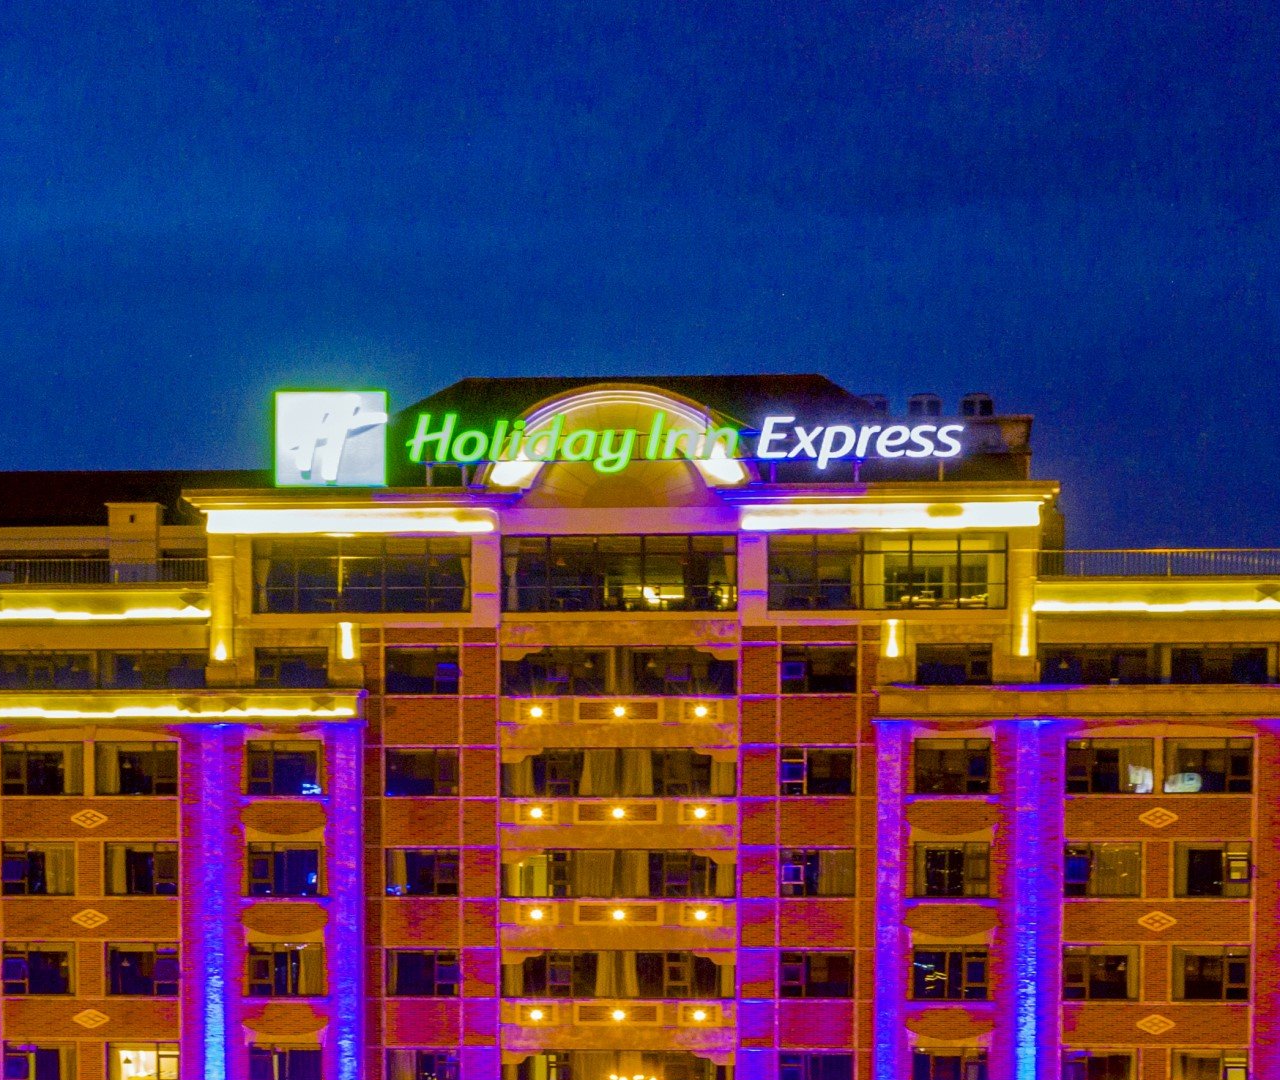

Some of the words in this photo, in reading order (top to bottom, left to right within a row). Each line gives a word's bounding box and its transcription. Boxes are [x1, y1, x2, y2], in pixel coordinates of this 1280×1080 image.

[407, 412, 637, 473] Holiday
[645, 410, 739, 461] Inn
[756, 415, 964, 470] Express
